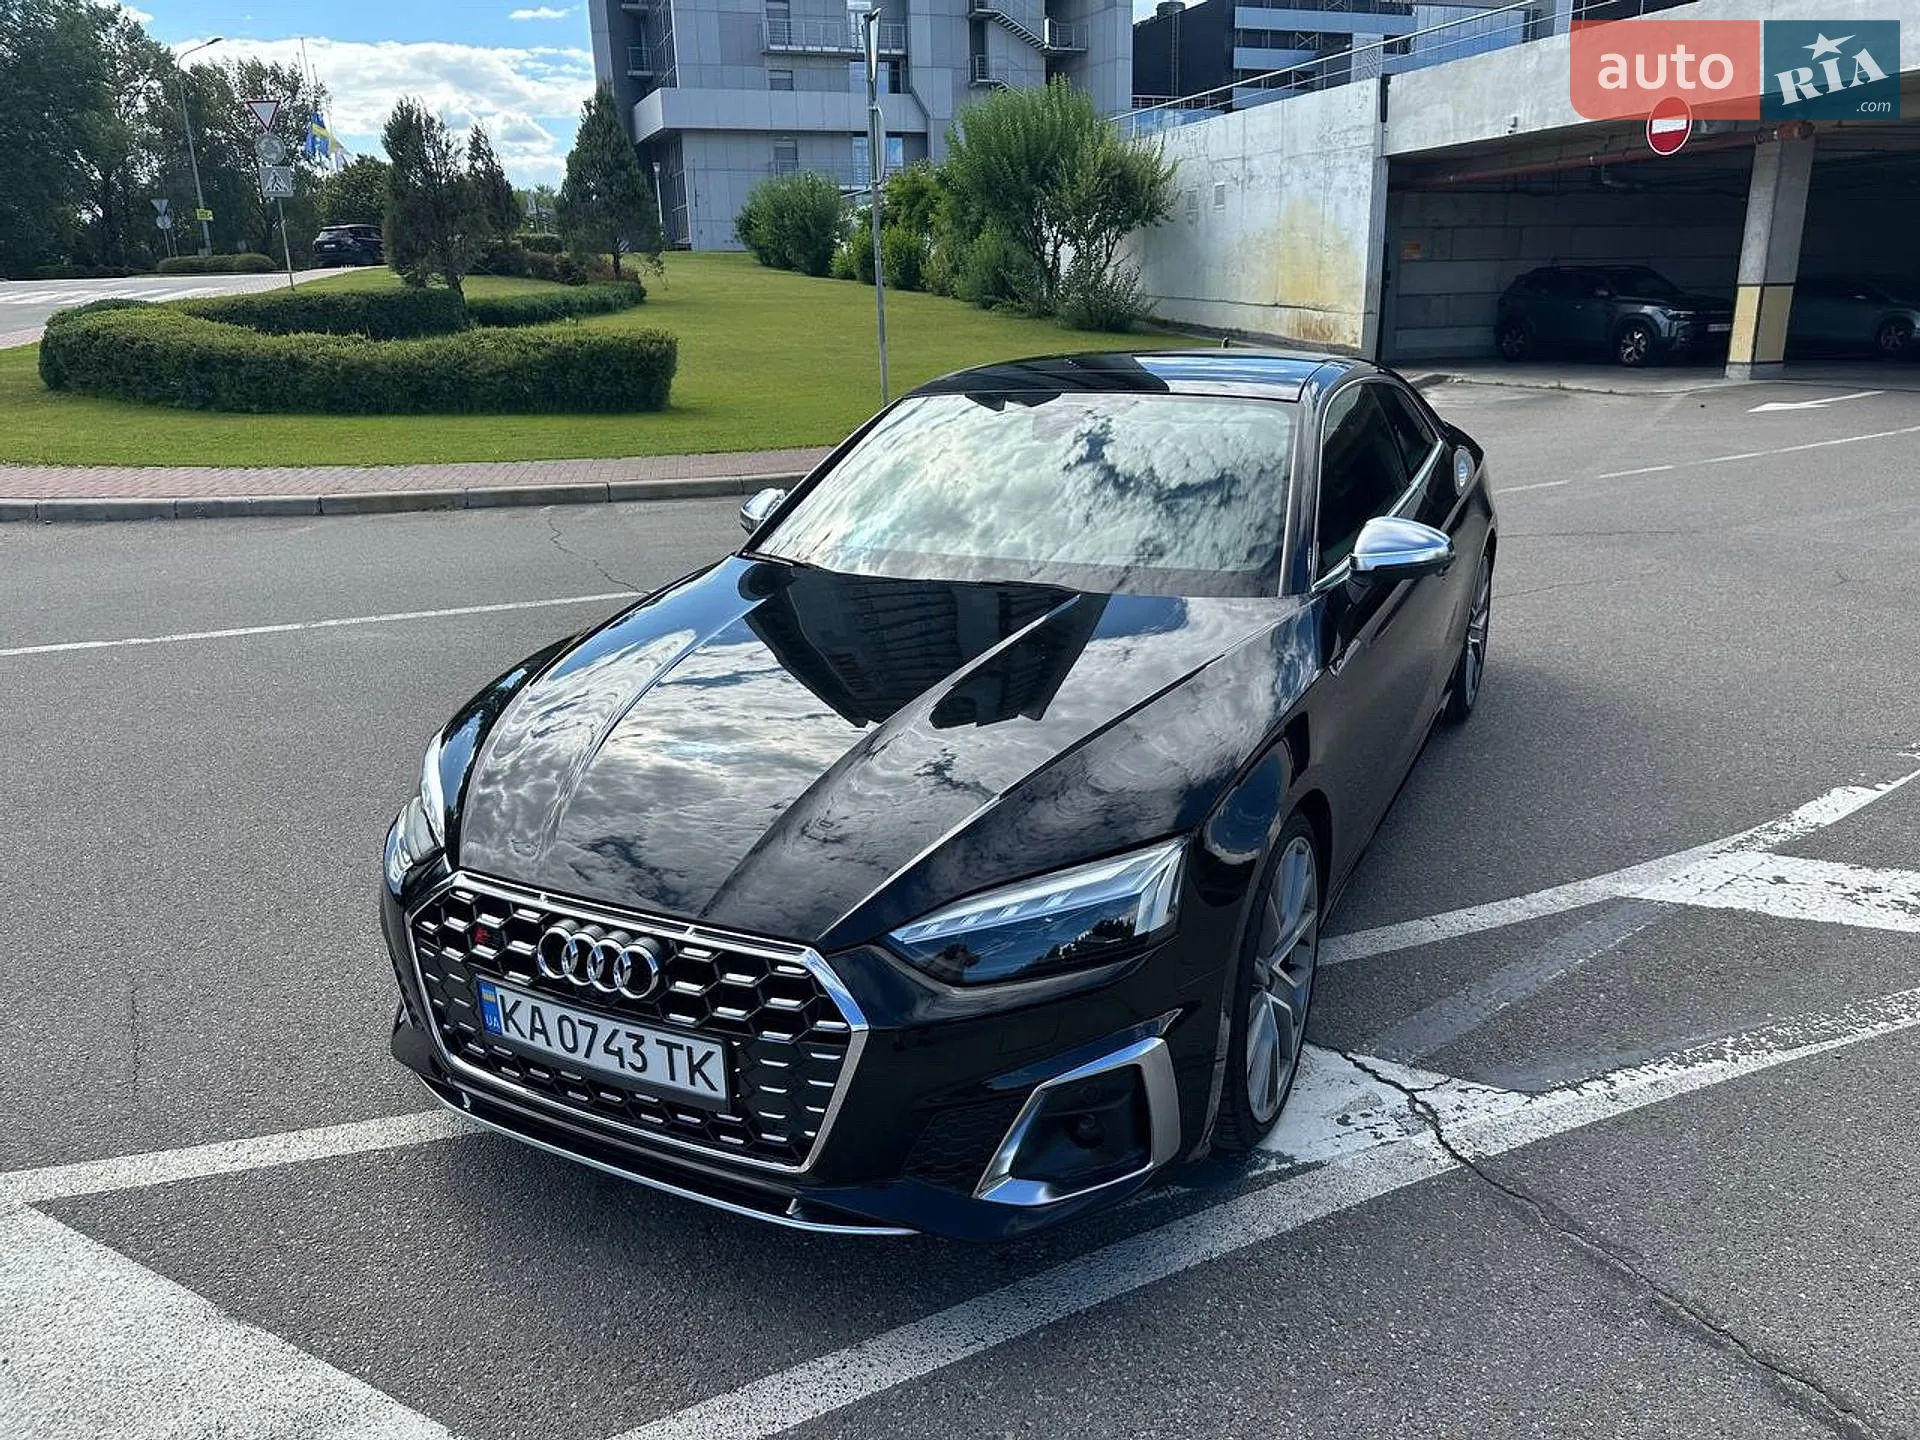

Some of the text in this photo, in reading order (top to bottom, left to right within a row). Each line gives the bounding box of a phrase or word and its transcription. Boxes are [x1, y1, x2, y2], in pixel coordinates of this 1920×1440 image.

[499, 994, 719, 1092] KA 0743 TK
